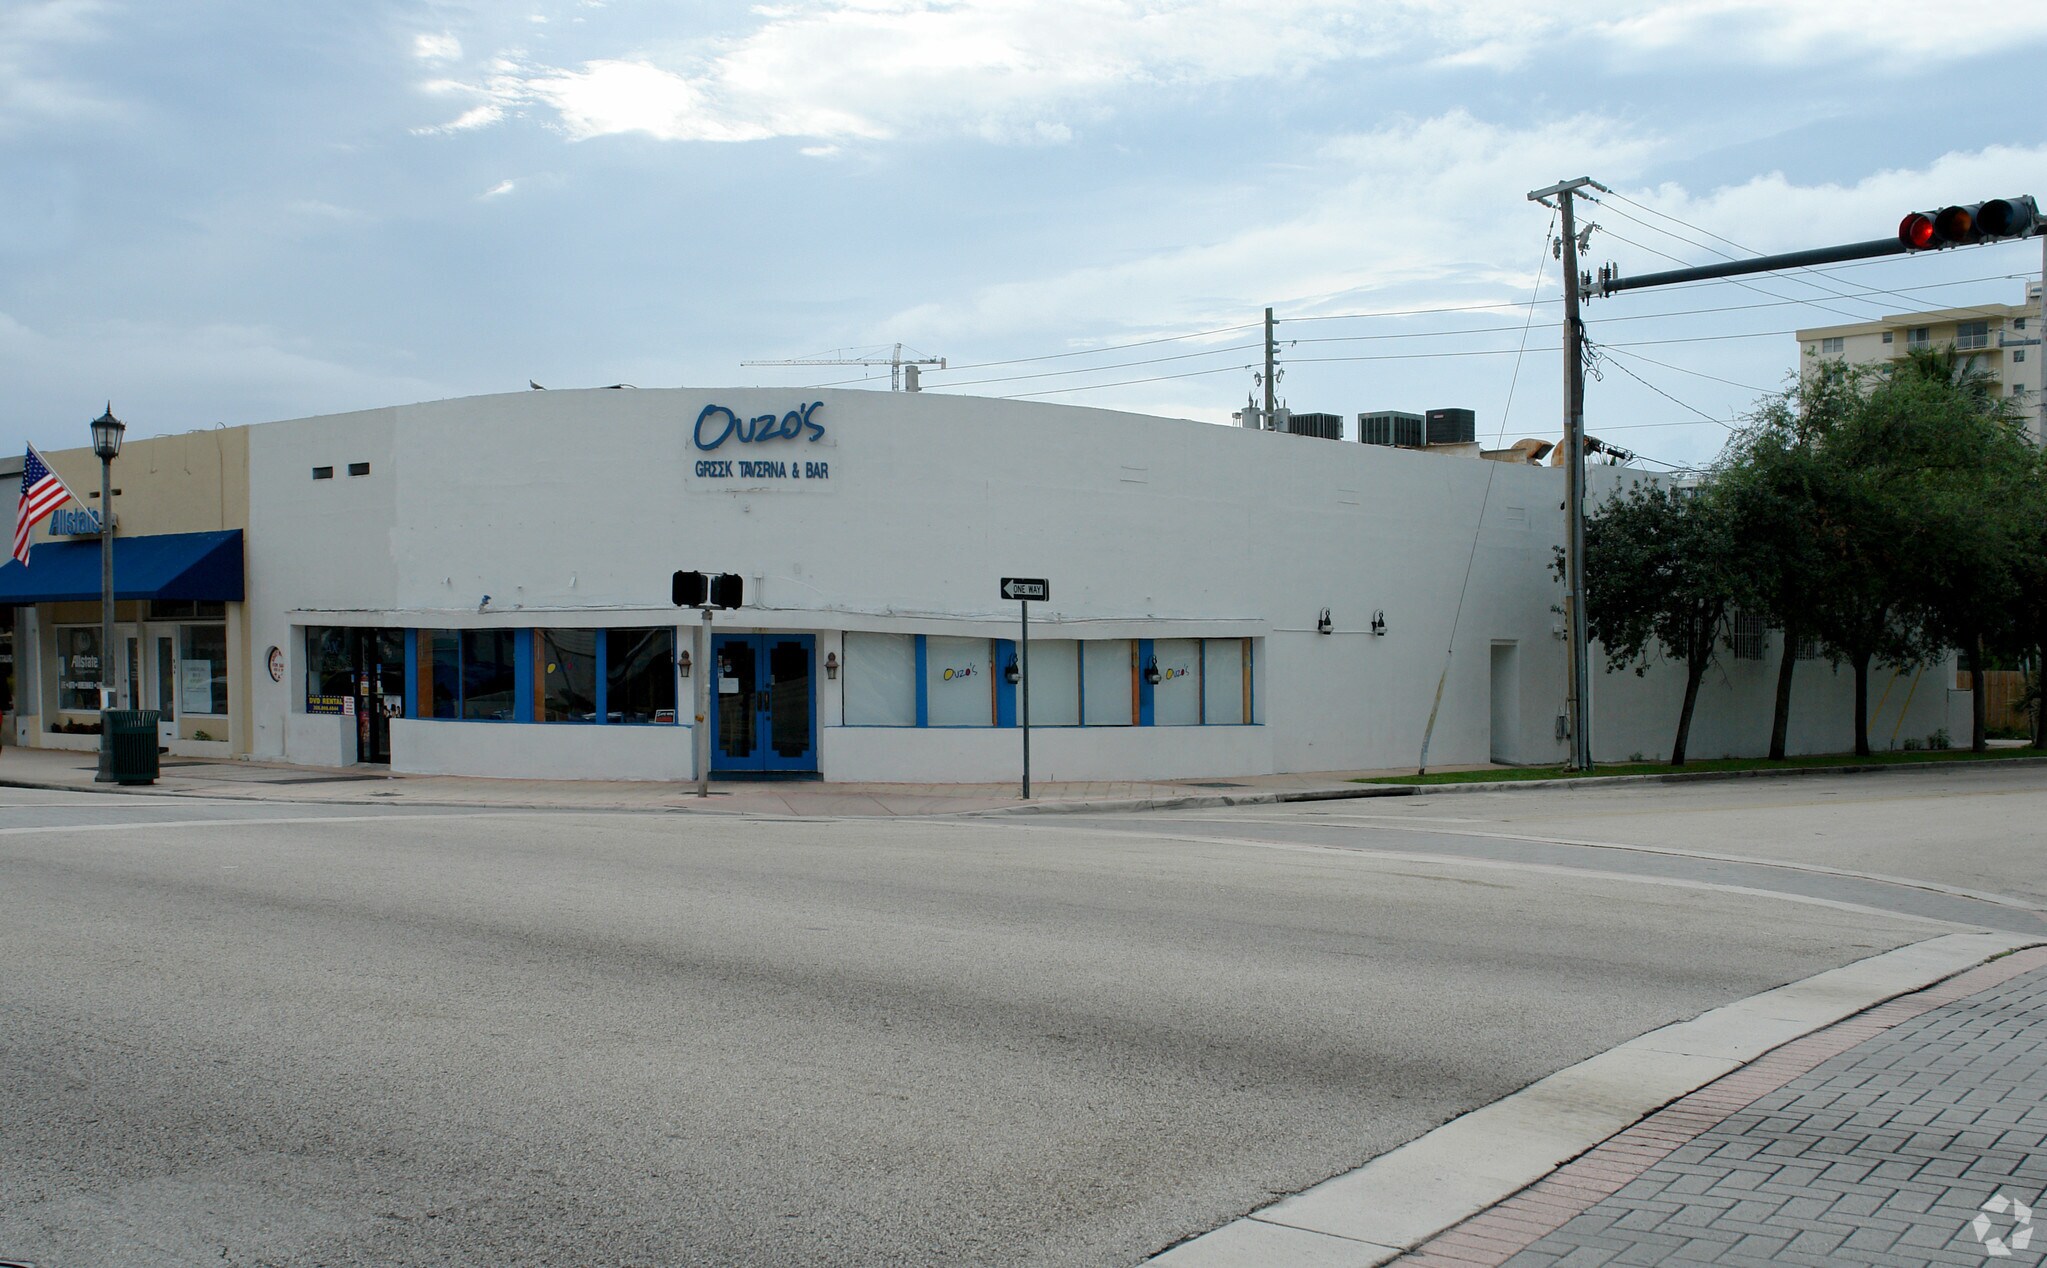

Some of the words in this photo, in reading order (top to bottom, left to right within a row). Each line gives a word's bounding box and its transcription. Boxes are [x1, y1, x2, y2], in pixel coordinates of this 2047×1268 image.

[792, 462, 800, 479] &
[806, 462, 829, 479] BAR
[48, 507, 100, 536] Allstate
[1013, 584, 1026, 594] ONE
[1028, 585, 1042, 594] WAY
[71, 654, 99, 668] Allstate
[322, 697, 344, 705] RENTAL
